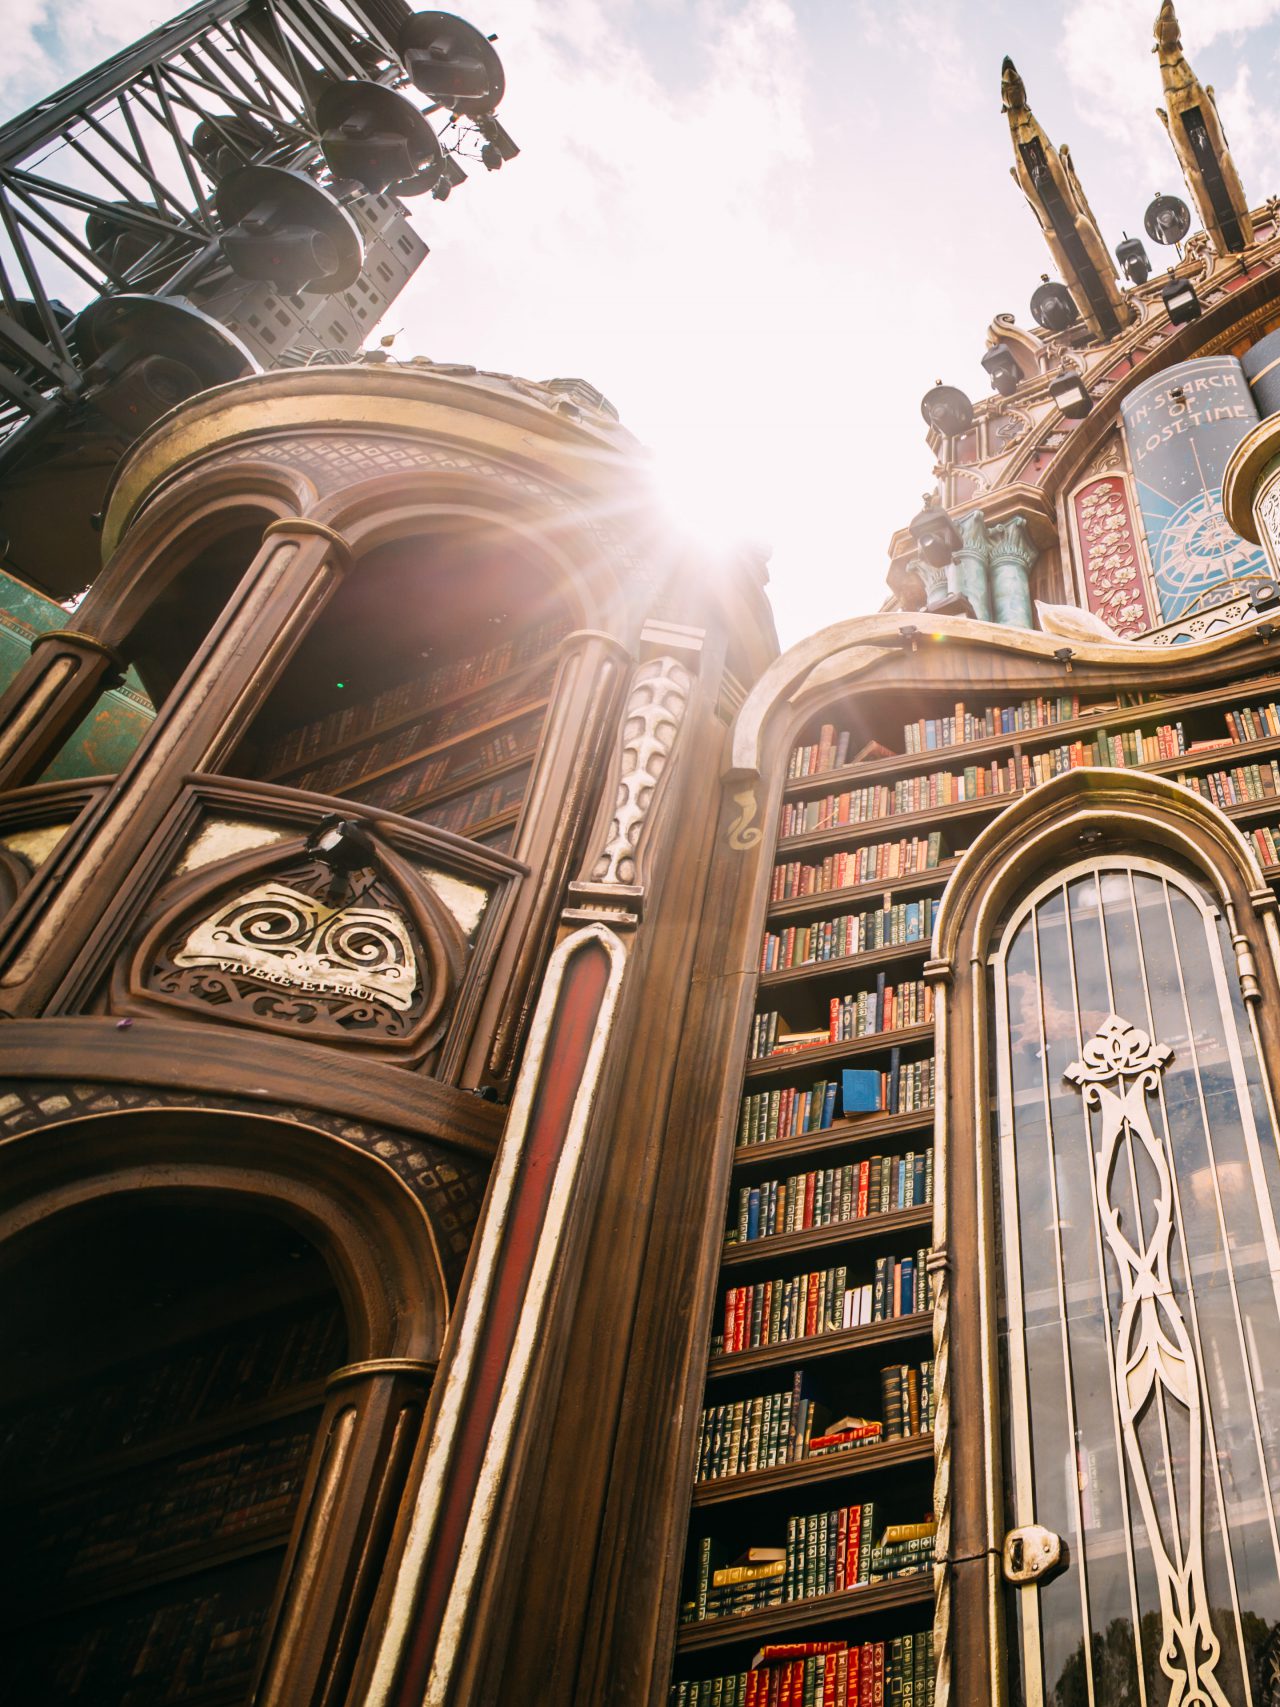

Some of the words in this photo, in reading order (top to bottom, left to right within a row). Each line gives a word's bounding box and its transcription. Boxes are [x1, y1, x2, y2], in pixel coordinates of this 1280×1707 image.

[1130, 404, 1148, 428] IN
[1135, 418, 1184, 462] LOST
[1189, 405, 1249, 426] TIME
[218, 961, 291, 987] VIVERE
[301, 981, 328, 992] ET
[334, 982, 375, 1001] FRUI
